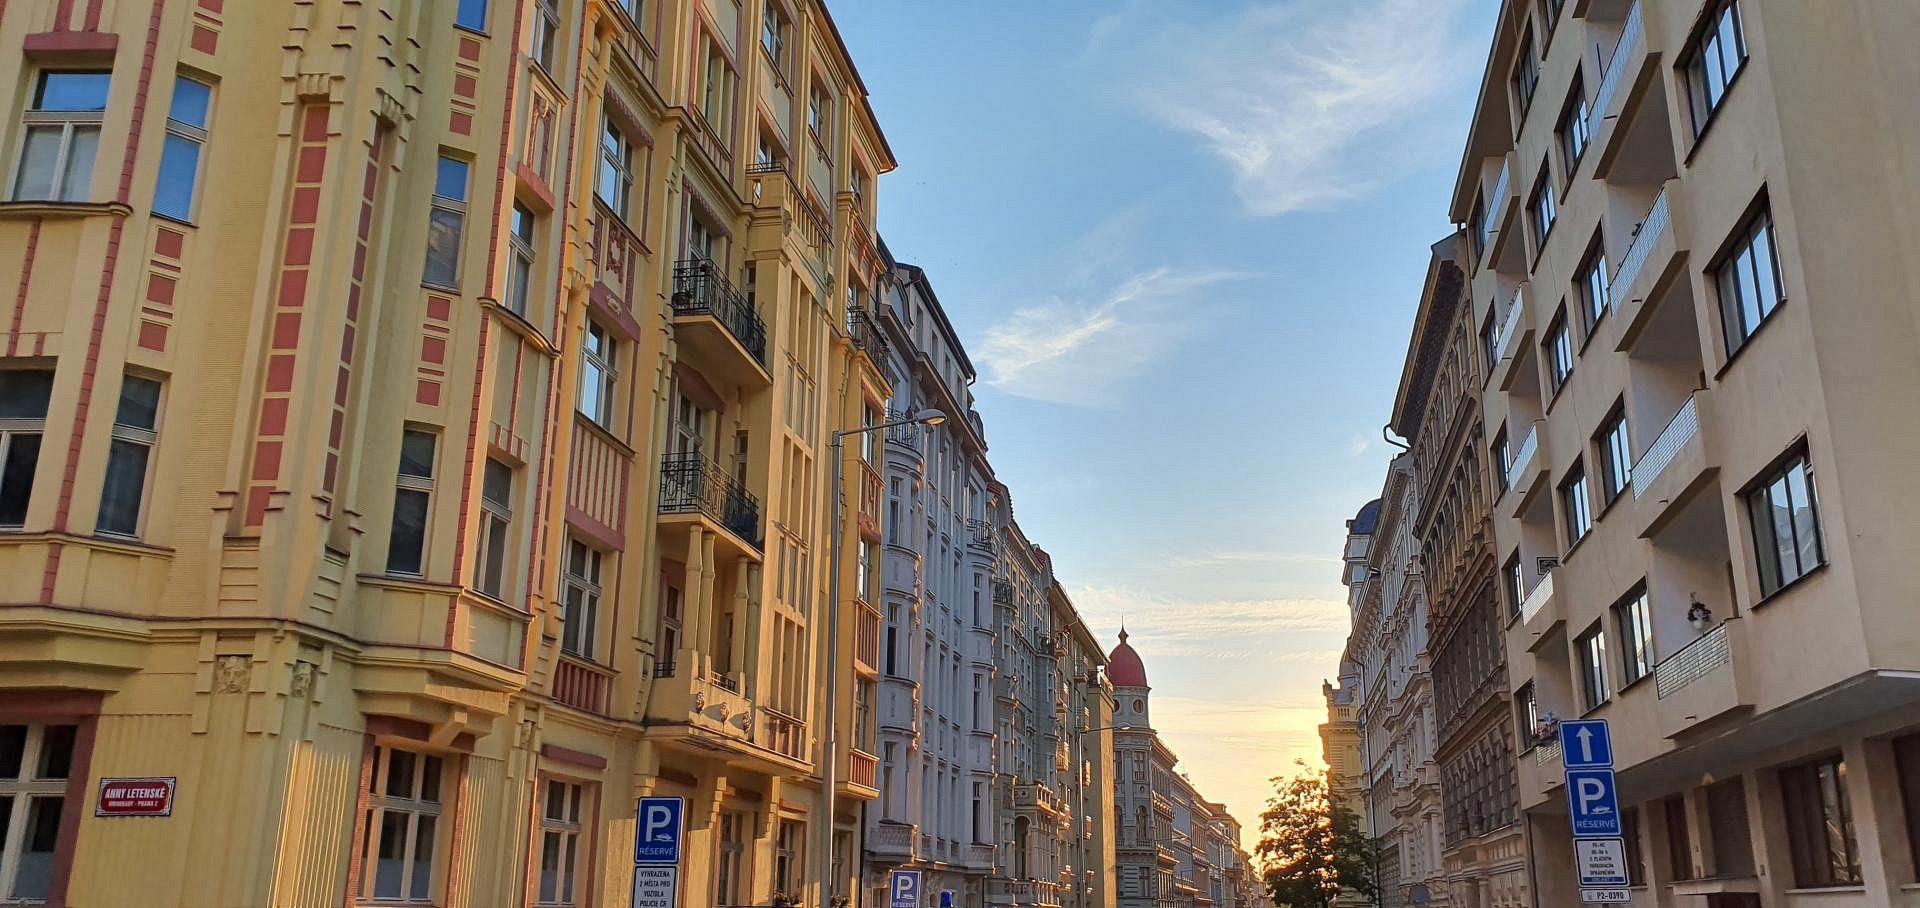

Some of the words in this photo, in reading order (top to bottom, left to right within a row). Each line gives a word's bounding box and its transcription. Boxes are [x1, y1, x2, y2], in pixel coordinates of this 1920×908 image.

[105, 788, 127, 799] ANNY
[127, 786, 166, 799] LETENSKÉ
[1577, 777, 1605, 815] P
[645, 805, 672, 842] P
[1576, 818, 1616, 829] RÉSERVÉ
[639, 845, 674, 855] RÉSERVÉ
[896, 876, 913, 899] P
